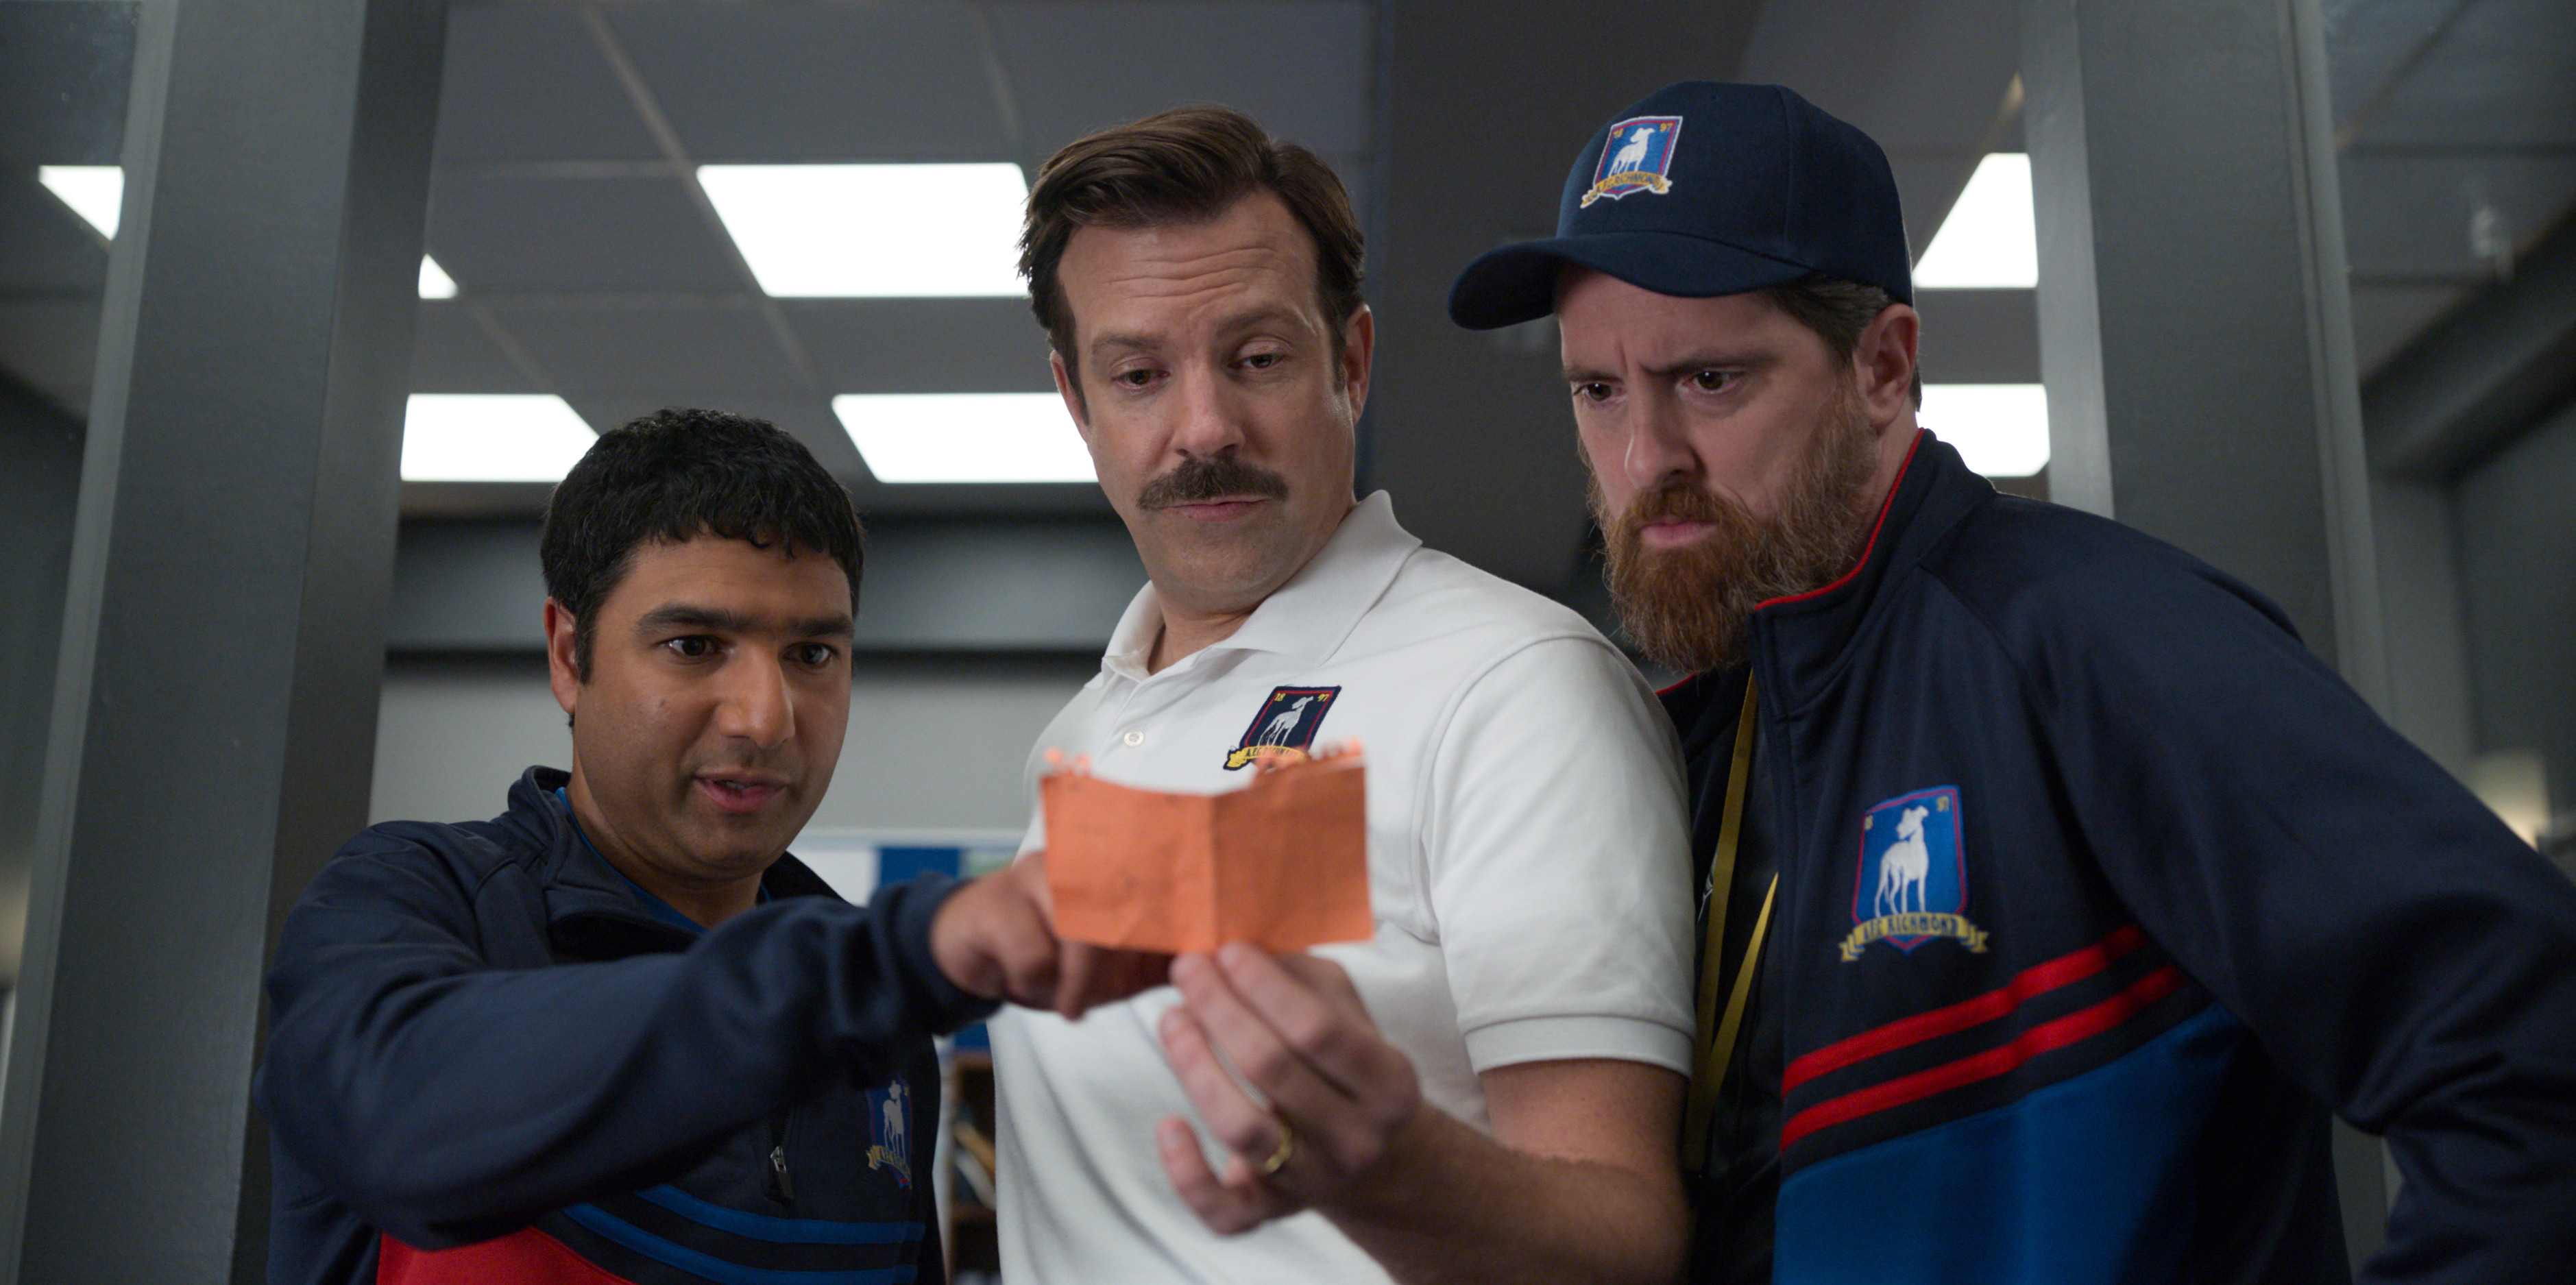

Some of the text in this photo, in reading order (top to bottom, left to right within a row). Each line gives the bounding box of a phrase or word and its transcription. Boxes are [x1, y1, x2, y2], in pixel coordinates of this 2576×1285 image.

[1660, 123, 1673, 132] 97
[1274, 693, 1285, 702] 18
[1317, 694, 1329, 702] 97
[1936, 796, 1949, 812] 97
[1887, 914, 1958, 935] RICHMOND
